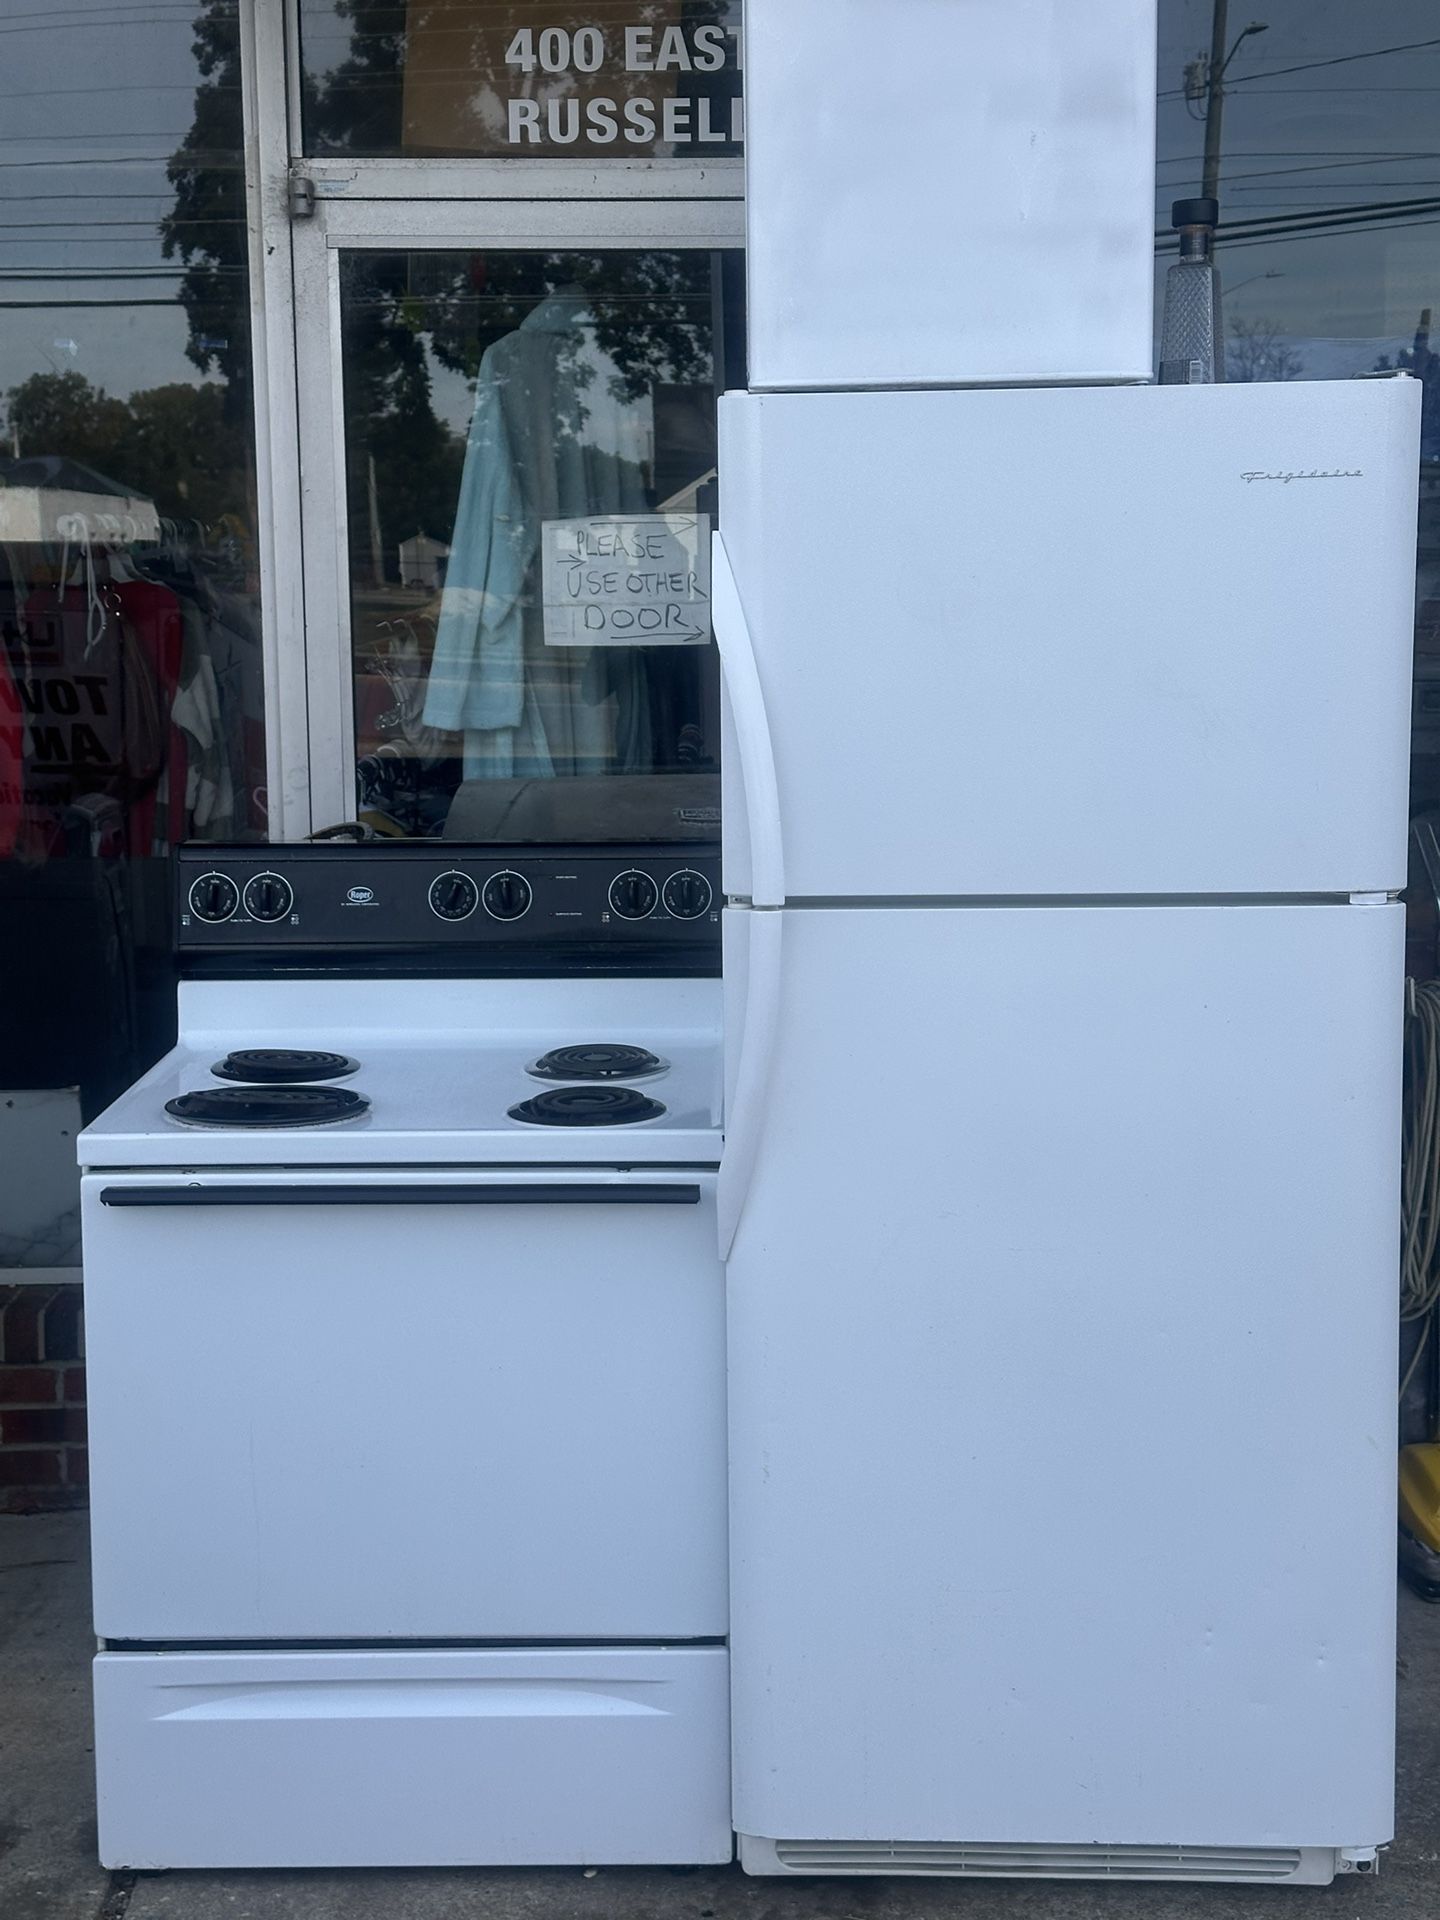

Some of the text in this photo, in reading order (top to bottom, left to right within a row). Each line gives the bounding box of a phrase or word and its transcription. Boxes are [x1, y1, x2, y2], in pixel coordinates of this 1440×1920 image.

[504, 27, 604, 73] 400
[576, 530, 667, 559] PLEASE
[567, 571, 708, 599] USE OTHER
[584, 603, 689, 630] DOOR
